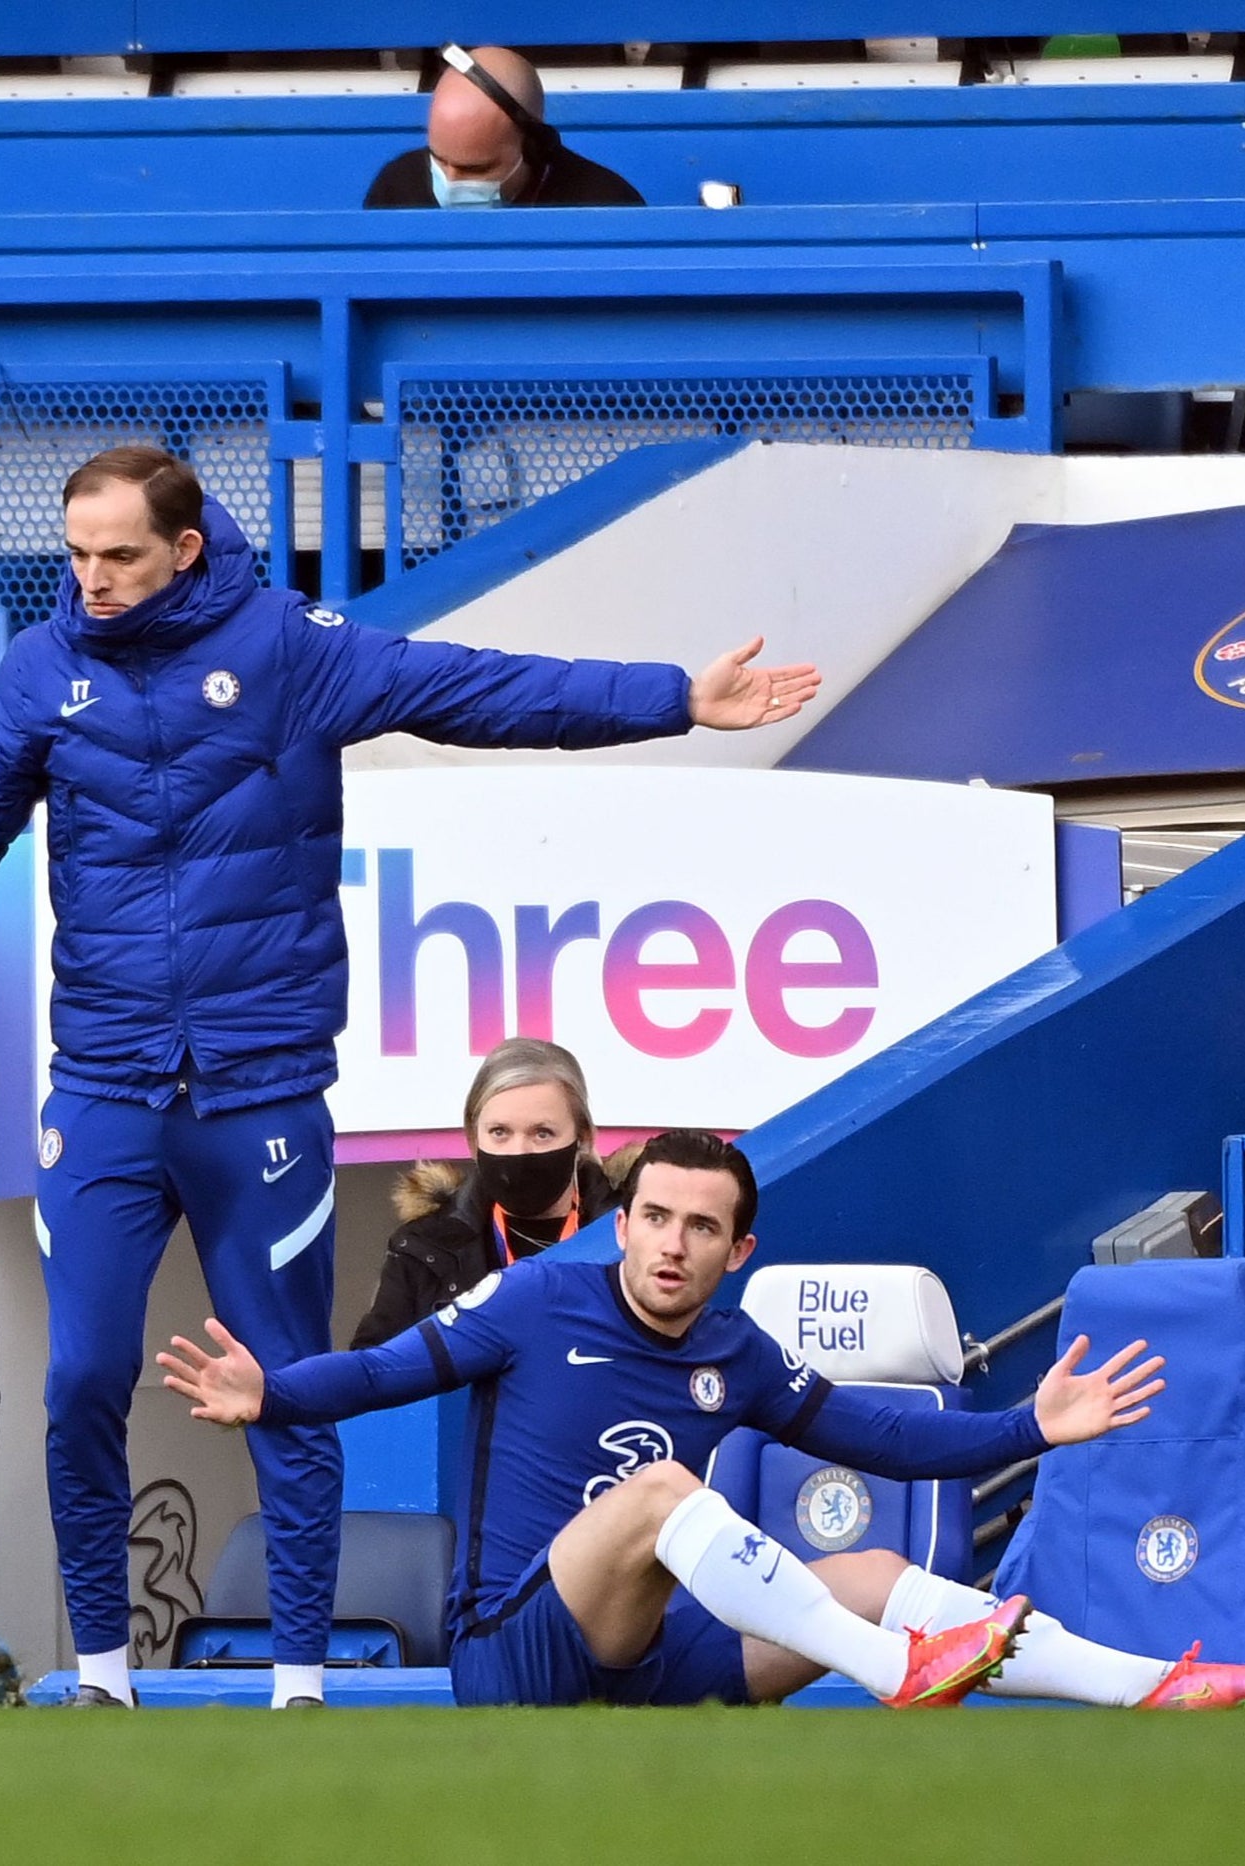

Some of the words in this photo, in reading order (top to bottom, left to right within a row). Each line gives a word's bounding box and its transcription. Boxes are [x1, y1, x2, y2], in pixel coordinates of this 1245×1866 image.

[341, 848, 879, 1059] hree
[798, 1280, 869, 1313] Blue
[798, 1317, 865, 1351] Fuel
